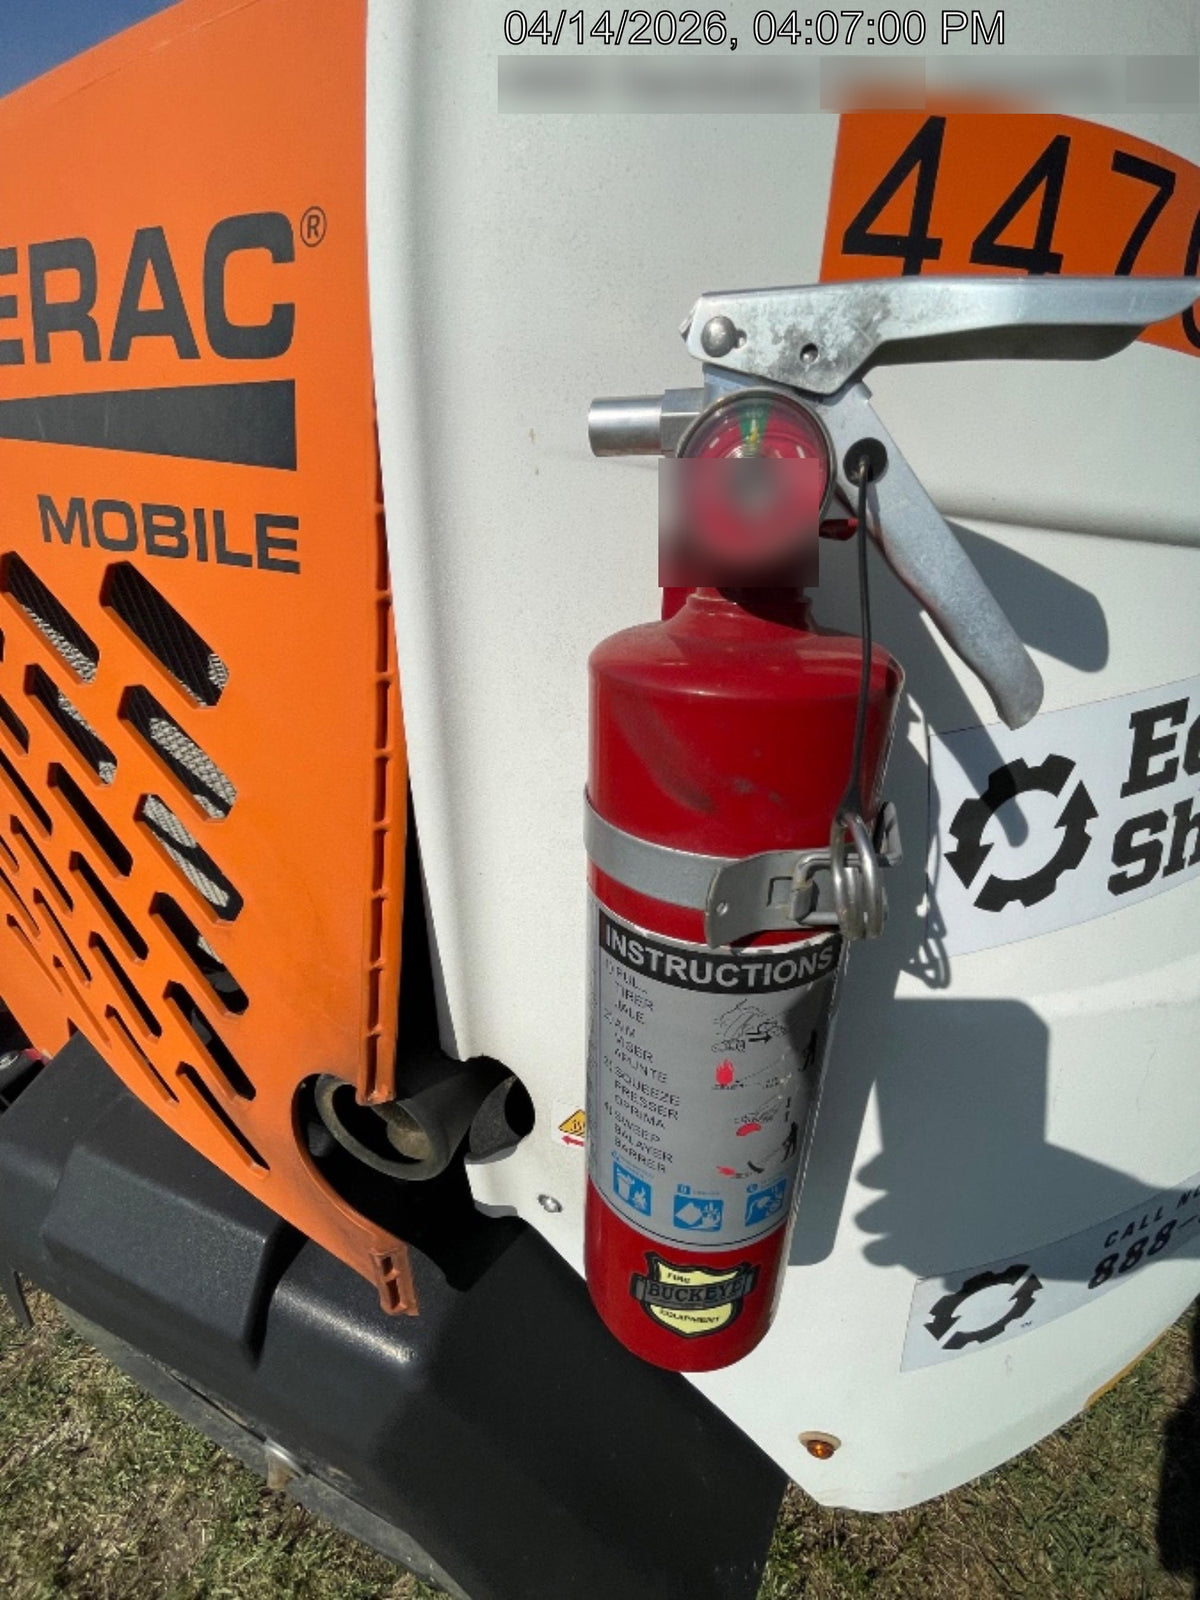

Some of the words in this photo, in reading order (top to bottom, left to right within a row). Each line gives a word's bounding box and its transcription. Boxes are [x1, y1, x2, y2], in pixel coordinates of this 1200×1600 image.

[841, 115, 1200, 350] 447
[37, 494, 300, 575] MOBILE
[605, 924, 834, 988] INSTRUCTIONS
[1104, 1206, 1163, 1248] CALL
[648, 1278, 741, 1302] BUCKEYE
